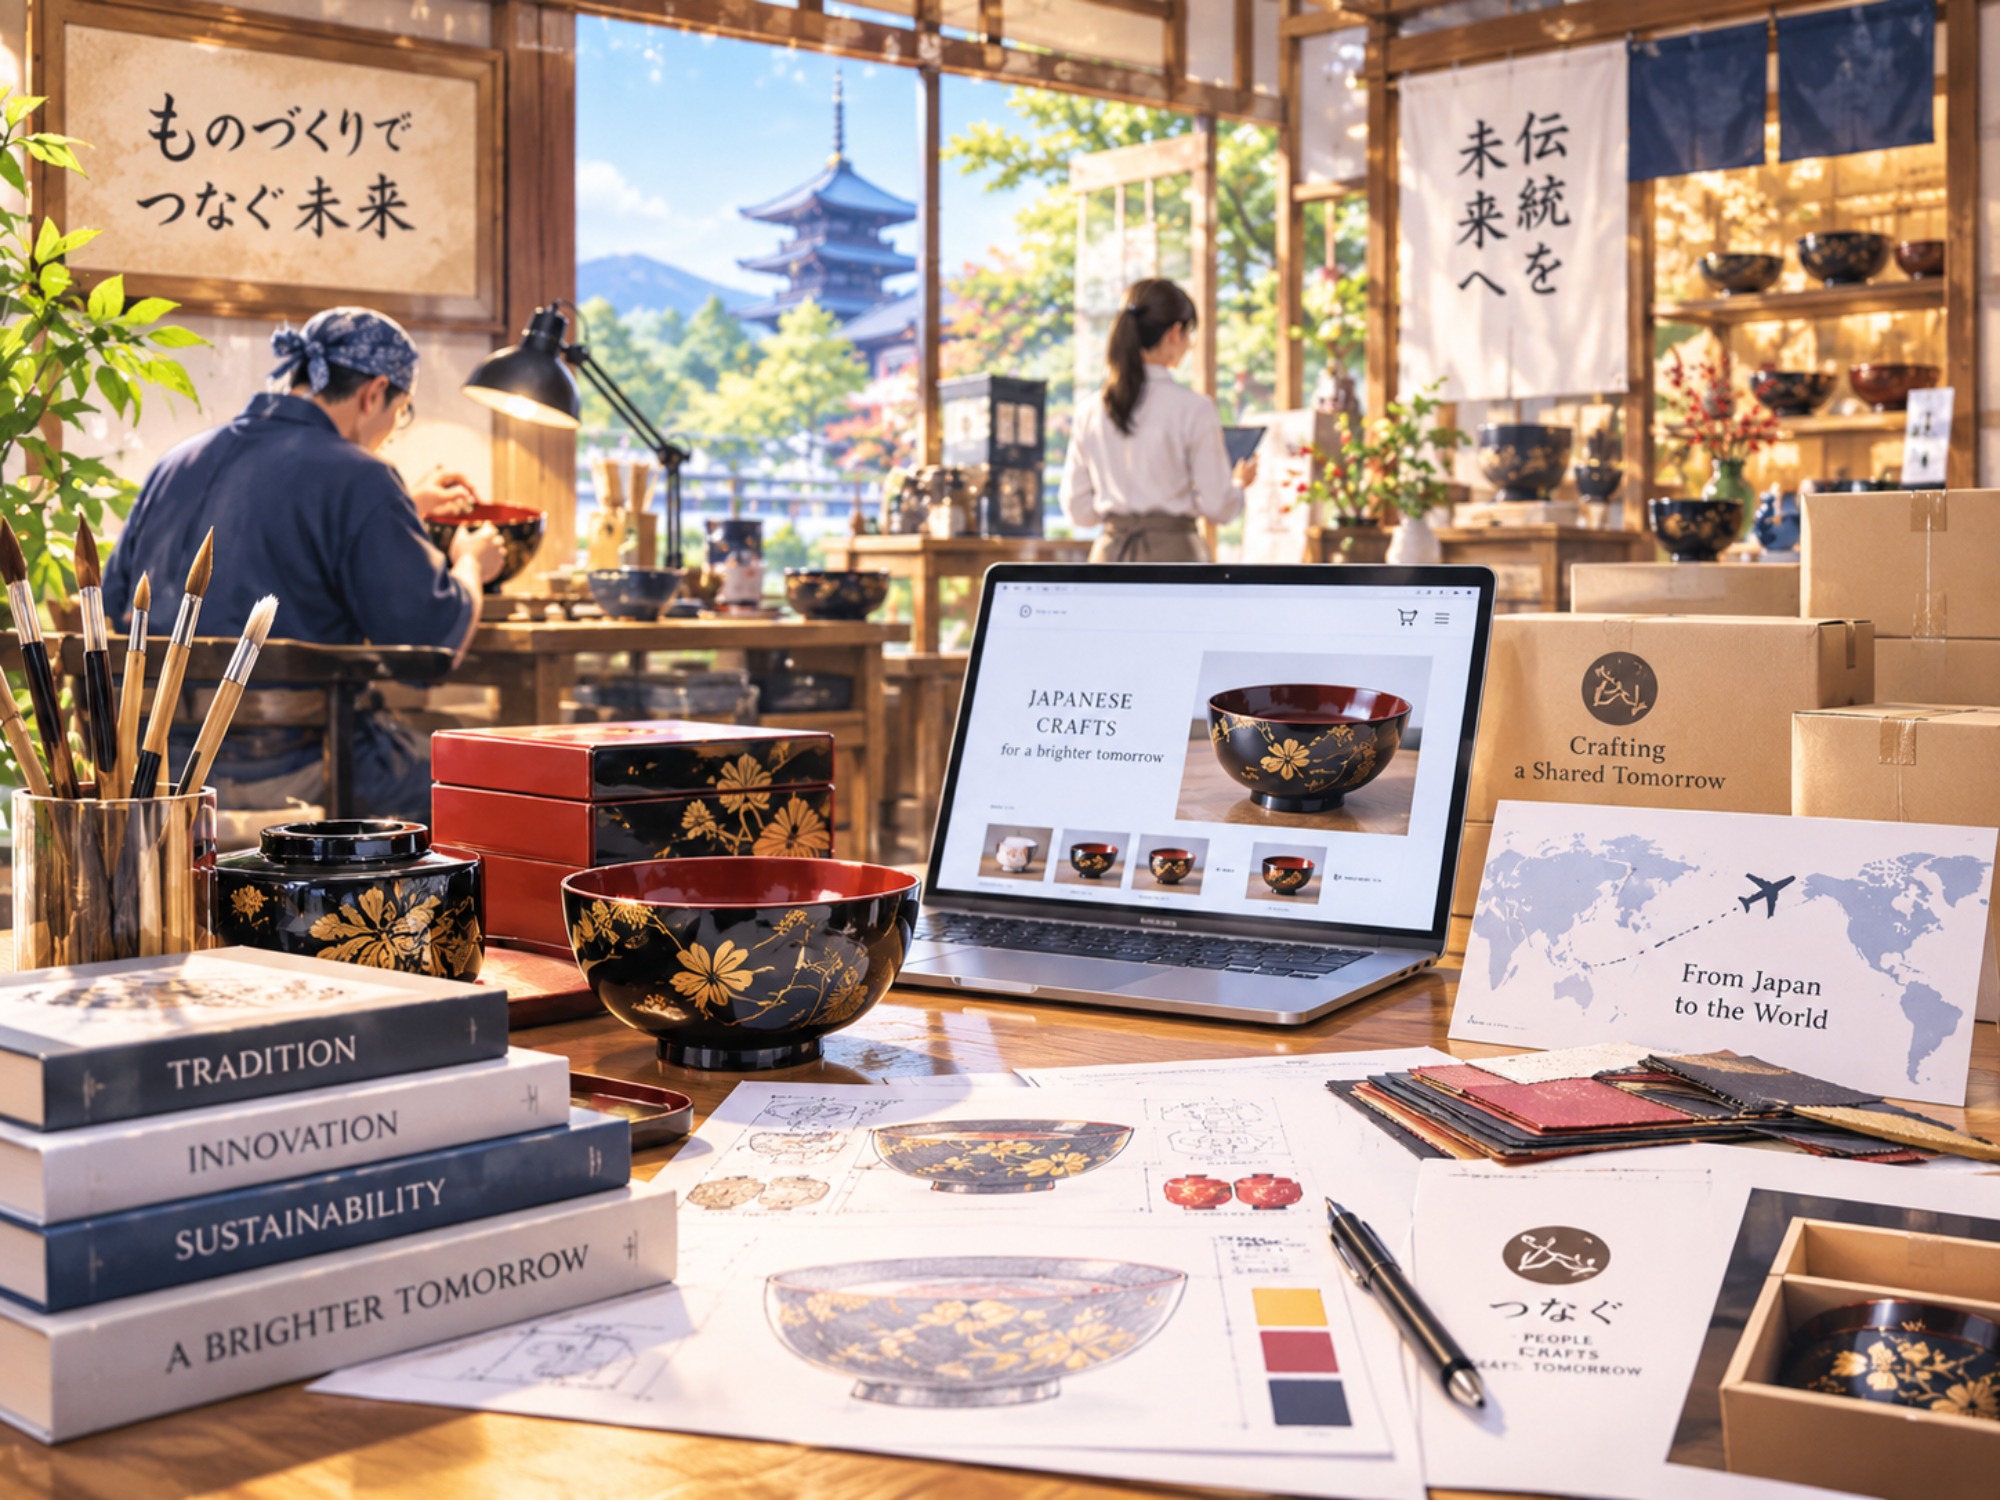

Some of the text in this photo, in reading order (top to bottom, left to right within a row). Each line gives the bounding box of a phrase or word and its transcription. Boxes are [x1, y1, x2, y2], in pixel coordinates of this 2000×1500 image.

[147, 92, 413, 163] ものづくりで
[1458, 119, 1508, 297] 未来へ
[1516, 111, 1572, 296] 伝統を
[1028, 689, 1134, 710] JAPANESE
[1036, 717, 1118, 737] CRAFTS
[1000, 742, 1165, 764] for a brighter tomorrow
[1569, 735, 1667, 764] Crafting
[1514, 760, 1726, 791] a Shared Tomorrow
[1681, 962, 1822, 997] From Japan
[1674, 996, 1829, 1030] to the World
[167, 1035, 357, 1091] TRADITION
[187, 1110, 399, 1175] INNOVATION
[174, 1178, 448, 1262] SUSTAINABILITY
[165, 1243, 590, 1375] A BRIGHTER TOMORROW
[1490, 1297, 1624, 1325] つなぐ
[1523, 1332, 1593, 1346] PEOPLE
[1532, 1361, 1643, 1377] TOMORROW
